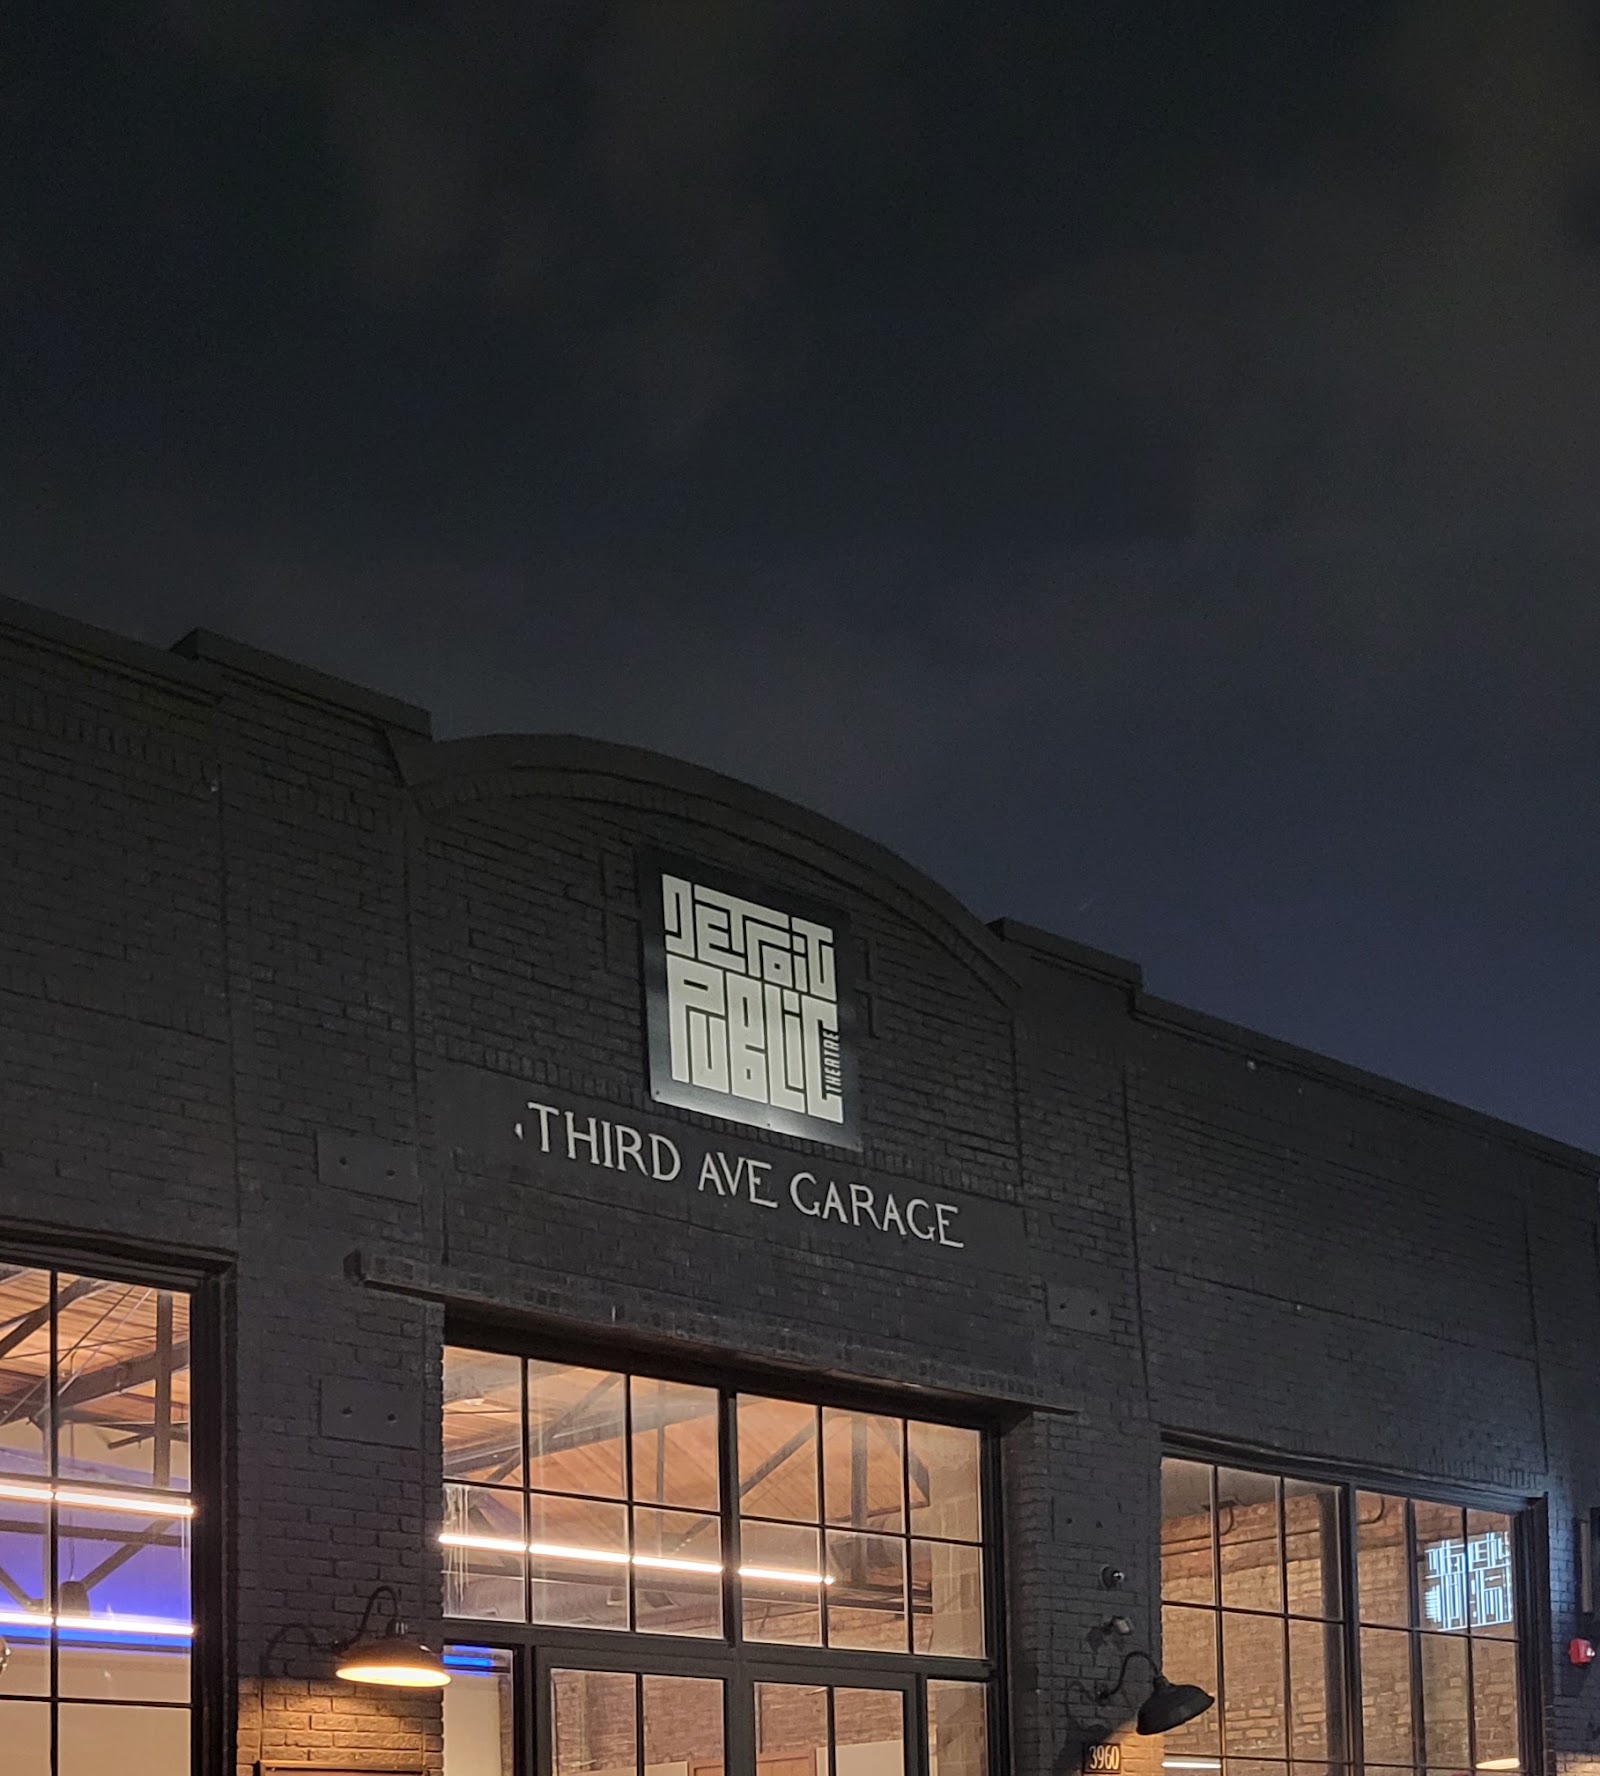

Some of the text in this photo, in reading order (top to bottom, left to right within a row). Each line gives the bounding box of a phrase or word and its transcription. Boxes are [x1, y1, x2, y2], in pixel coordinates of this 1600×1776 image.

[822, 1029, 842, 1094] THEATRE
[527, 1101, 964, 1248] THIRD AVE GARAGE
[1089, 1745, 1120, 1771] 3960
